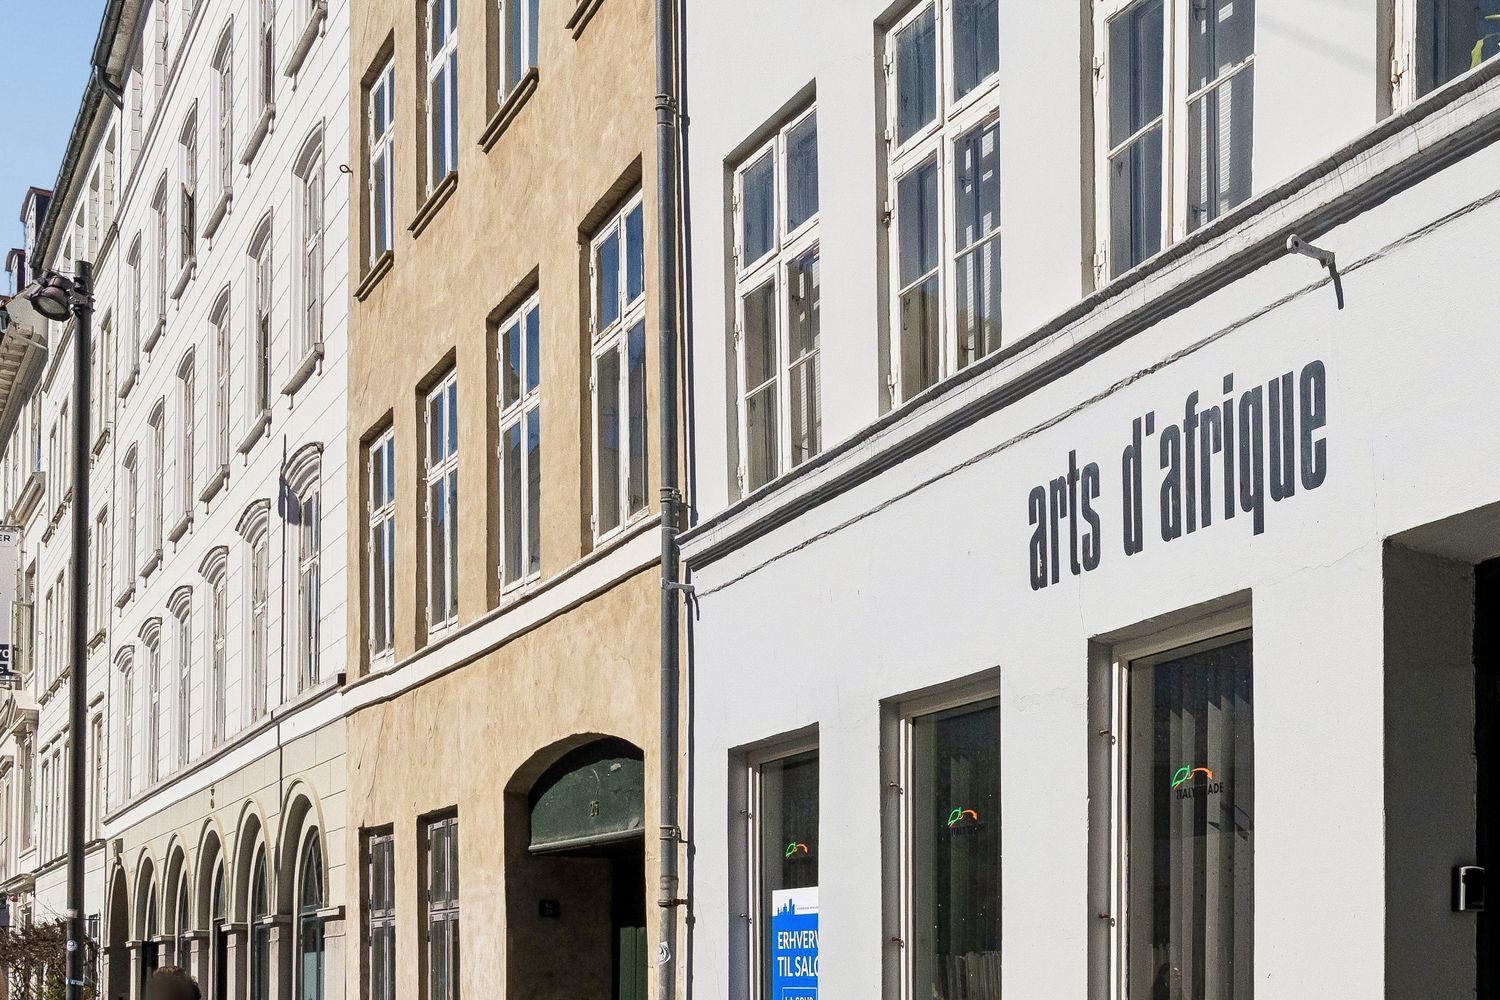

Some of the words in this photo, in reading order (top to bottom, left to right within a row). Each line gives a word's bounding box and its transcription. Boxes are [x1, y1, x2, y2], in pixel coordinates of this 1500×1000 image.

[1028, 448, 1101, 591] arts
[1122, 359, 1327, 557] d'afrique
[777, 956, 793, 977] TIL
